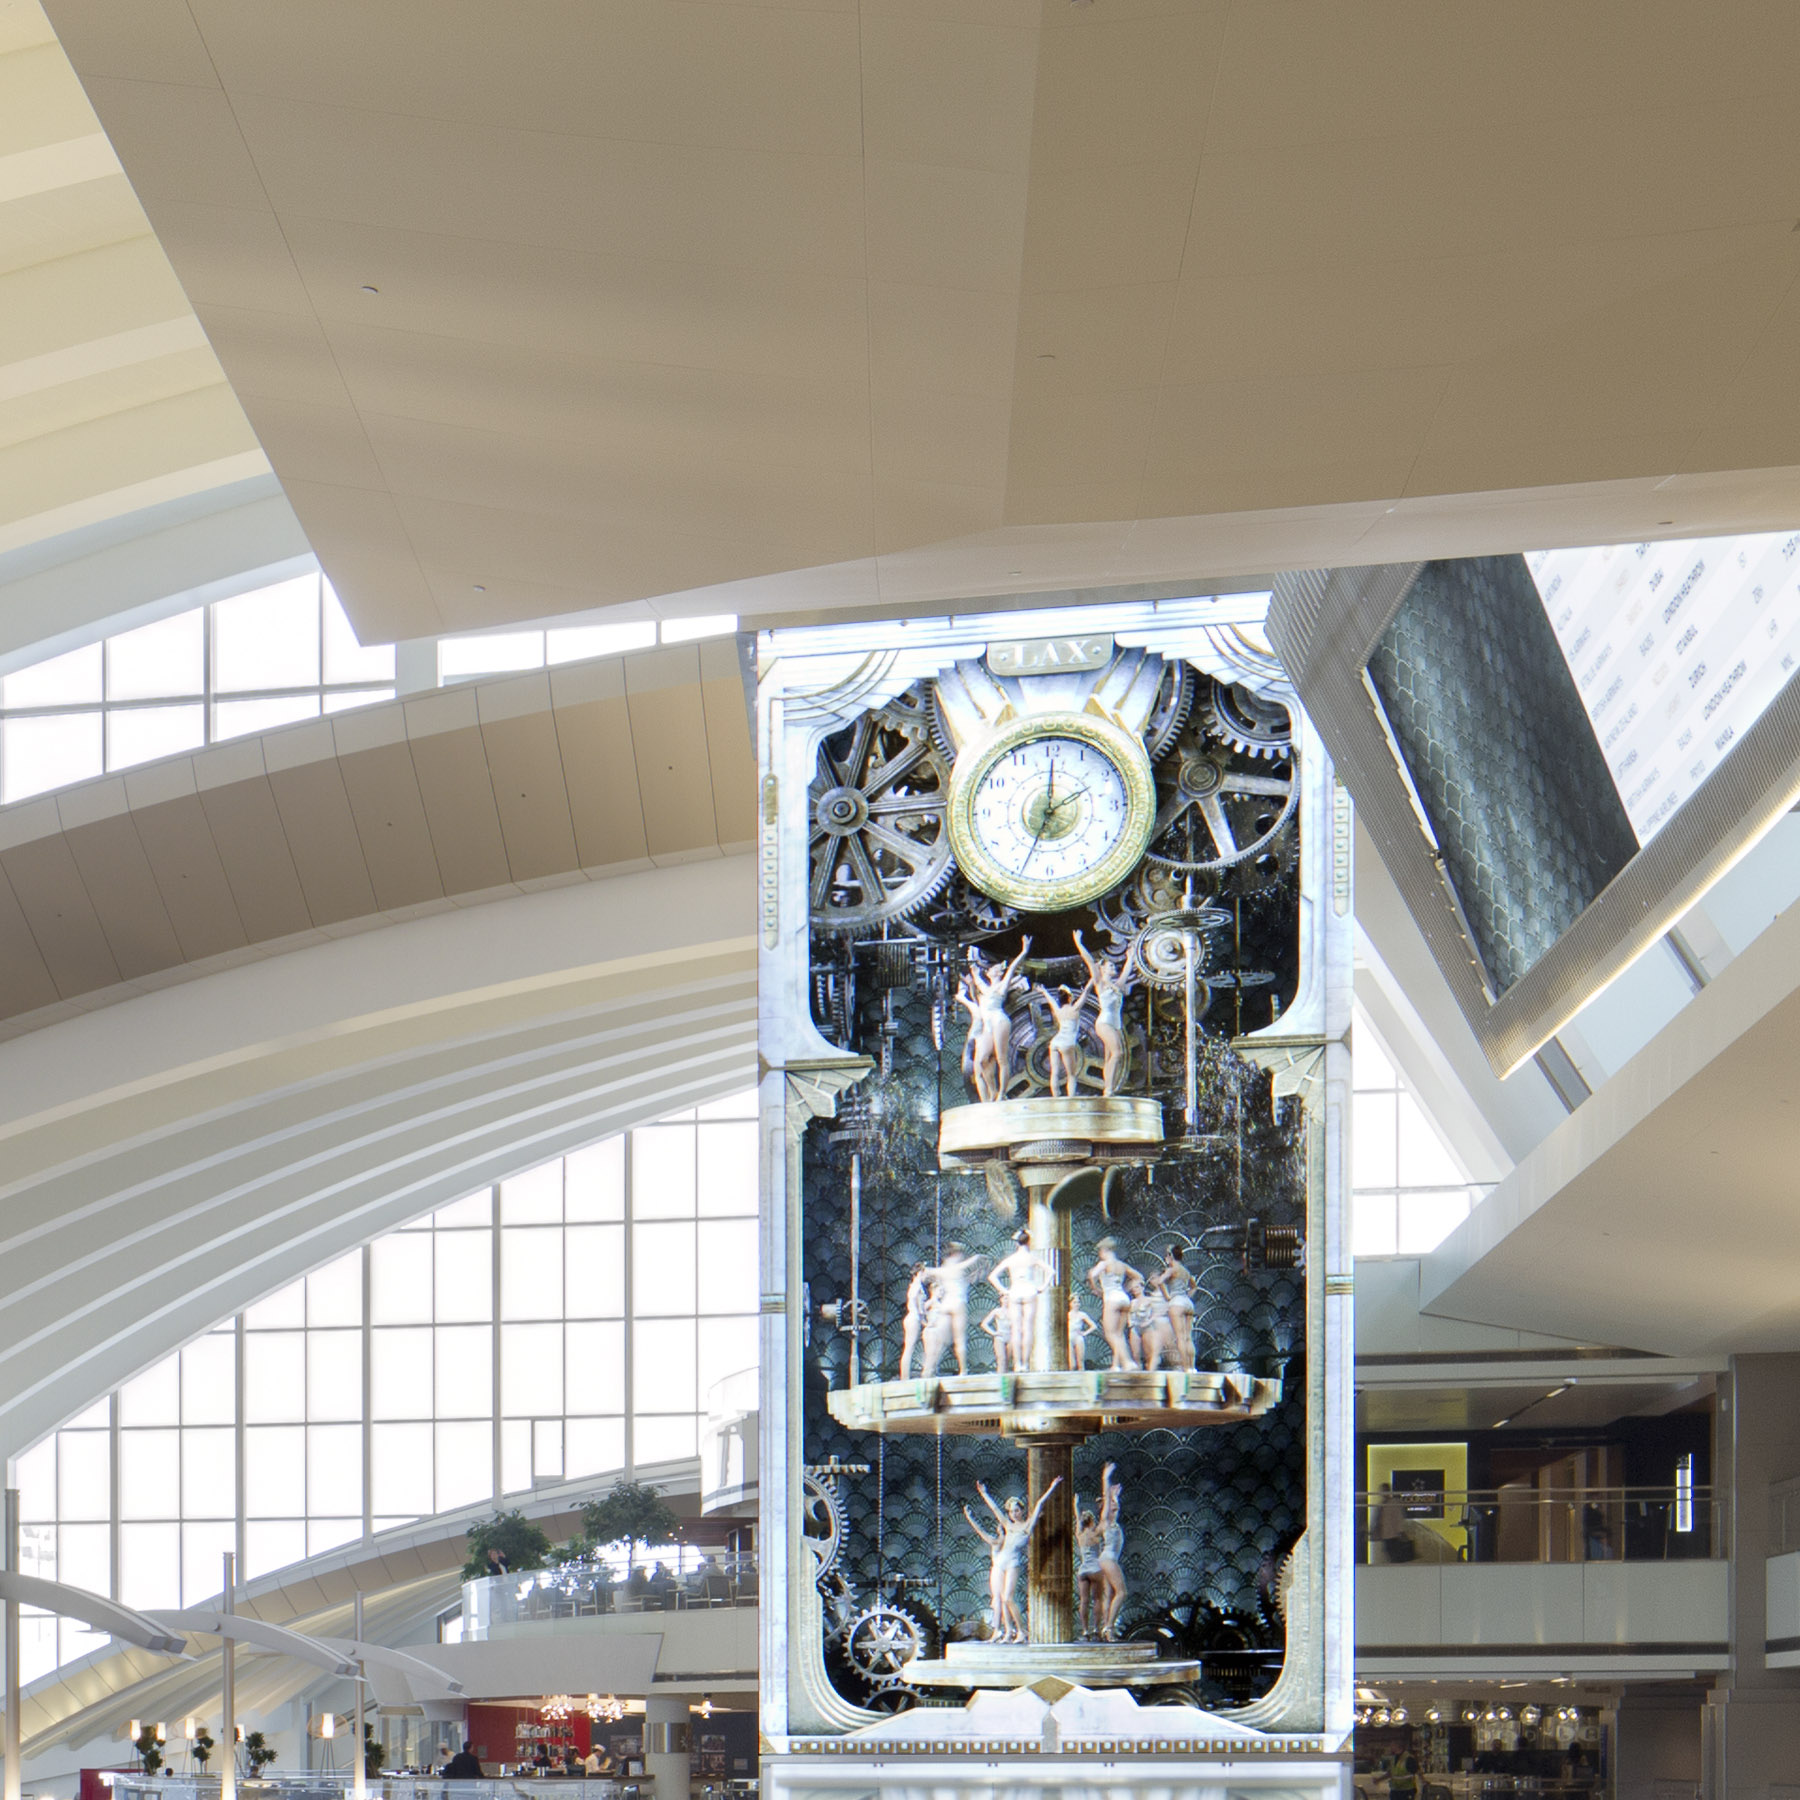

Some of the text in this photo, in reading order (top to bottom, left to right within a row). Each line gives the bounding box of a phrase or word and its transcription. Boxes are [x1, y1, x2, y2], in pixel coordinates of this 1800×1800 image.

[1012, 639, 1092, 669] LAX
[1045, 745, 1060, 757] 12
[1013, 754, 1026, 766] 11
[1101, 770, 1110, 782] 2
[989, 778, 1005, 789] 10
[1110, 800, 1119, 812] 3
